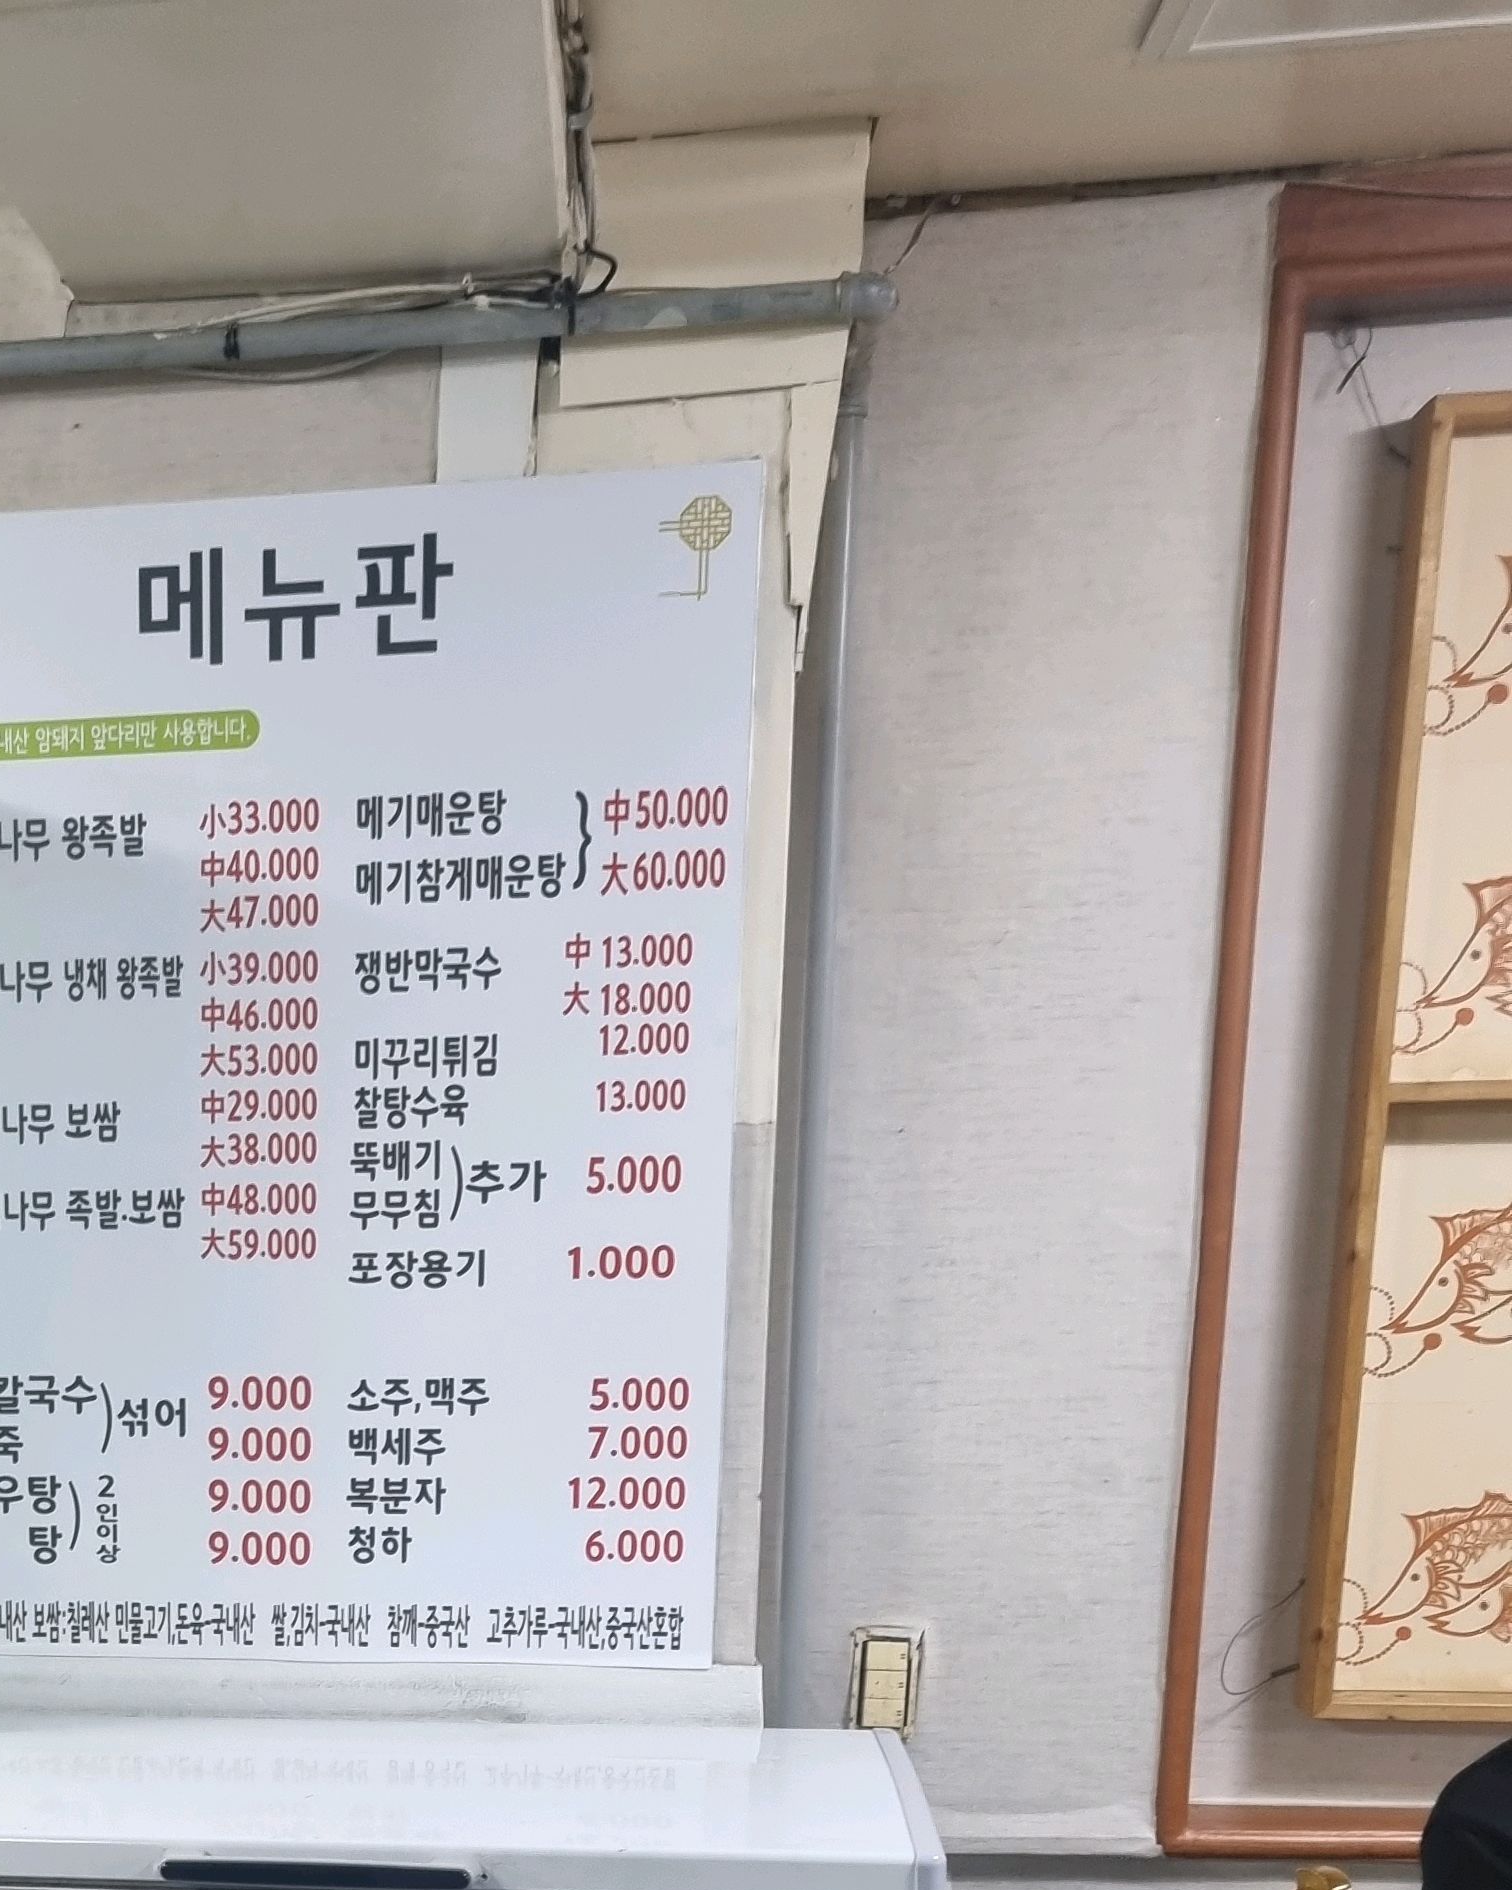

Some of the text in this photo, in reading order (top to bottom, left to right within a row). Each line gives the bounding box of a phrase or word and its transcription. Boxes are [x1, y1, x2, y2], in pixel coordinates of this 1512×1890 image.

[137, 532, 454, 665] 메뉴판
[36, 724, 84, 751] 암돼지
[91, 721, 157, 750] 앞다리만
[163, 716, 251, 747] 사용합니다.
[357, 789, 507, 839] 메기매운탕
[61, 813, 147, 861] 왕족발
[356, 852, 566, 906] 메기참게매운탕
[602, 933, 694, 969] 13.000
[64, 958, 107, 1001] 냉채
[116, 955, 184, 1000] 왕족발
[355, 947, 502, 995] 쟁반막국수
[600, 981, 692, 1016] 18.000
[355, 1033, 499, 1080] 미꾸리튀김
[599, 1022, 690, 1056] 12.000
[354, 1084, 469, 1129] 찰탕수육
[596, 1079, 686, 1112] 13.000
[65, 1101, 120, 1142] 보쌈
[350, 1139, 441, 1182] 뚝배기
[586, 1154, 682, 1194] 5.000
[465, 1160, 547, 1204] 추가
[66, 1188, 186, 1230] 족발.보쌈
[349, 1189, 440, 1231] 무무침
[348, 1249, 486, 1289] 포장용기
[567, 1244, 676, 1280] 1.000
[208, 1375, 312, 1411] 9.000
[347, 1378, 490, 1417] 소주,맥주
[589, 1377, 690, 1411] 5.000
[118, 1398, 187, 1438] 섞어
[208, 1426, 312, 1462] 9.000
[348, 1428, 446, 1466] 백세주
[587, 1426, 689, 1460] 7.000
[208, 1479, 312, 1514] 9.000
[347, 1477, 447, 1516] 복분자
[568, 1476, 686, 1510] 12.000
[208, 1531, 312, 1566] 9.000
[348, 1526, 412, 1565] 청하
[585, 1529, 684, 1563] 6.000
